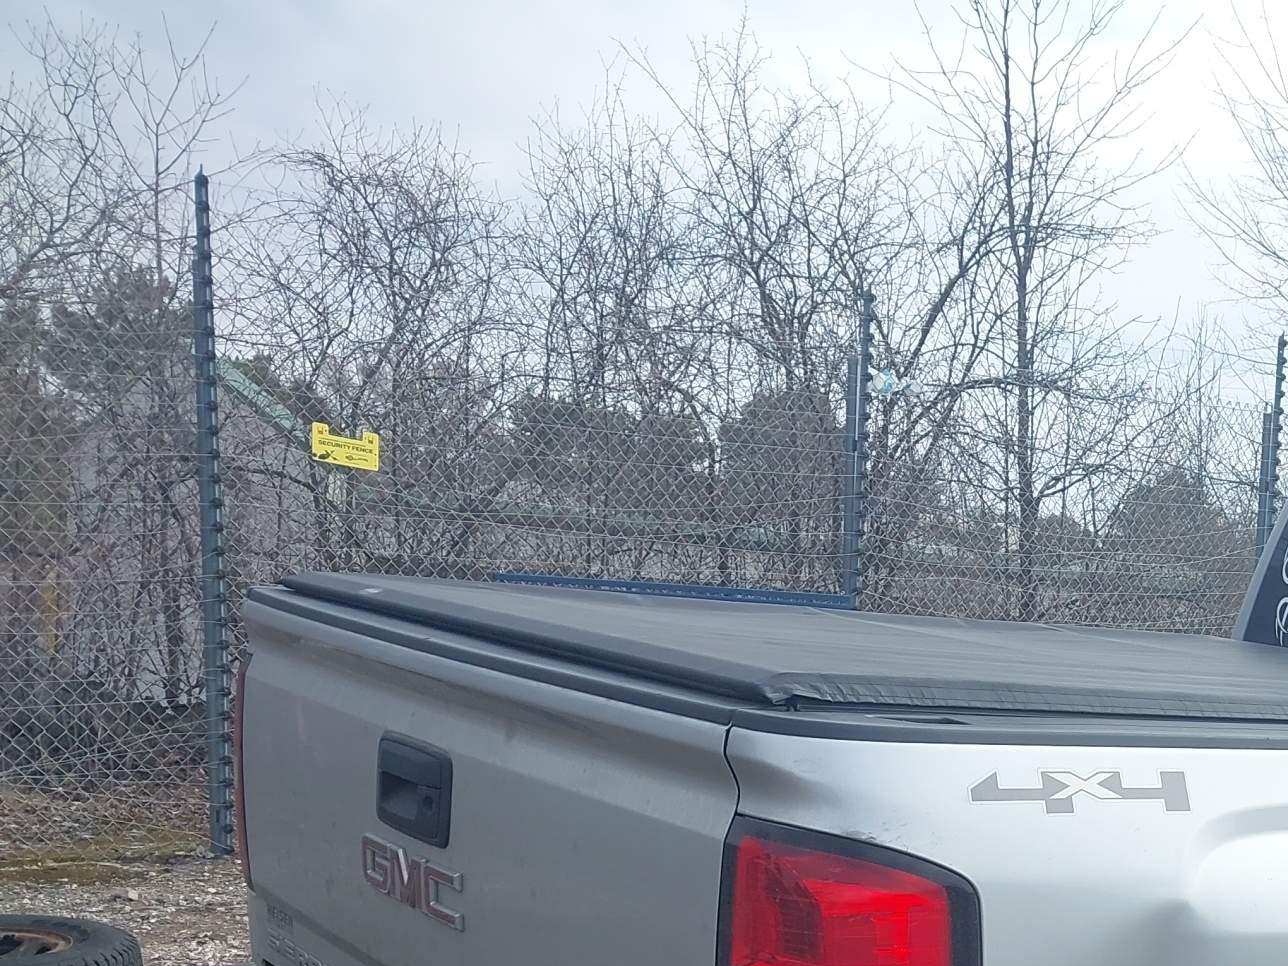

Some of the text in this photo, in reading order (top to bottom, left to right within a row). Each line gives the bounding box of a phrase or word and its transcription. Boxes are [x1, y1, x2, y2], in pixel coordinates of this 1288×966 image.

[318, 439, 351, 450] SECURITY
[352, 446, 374, 454] FENCE
[361, 832, 465, 932] GMC
